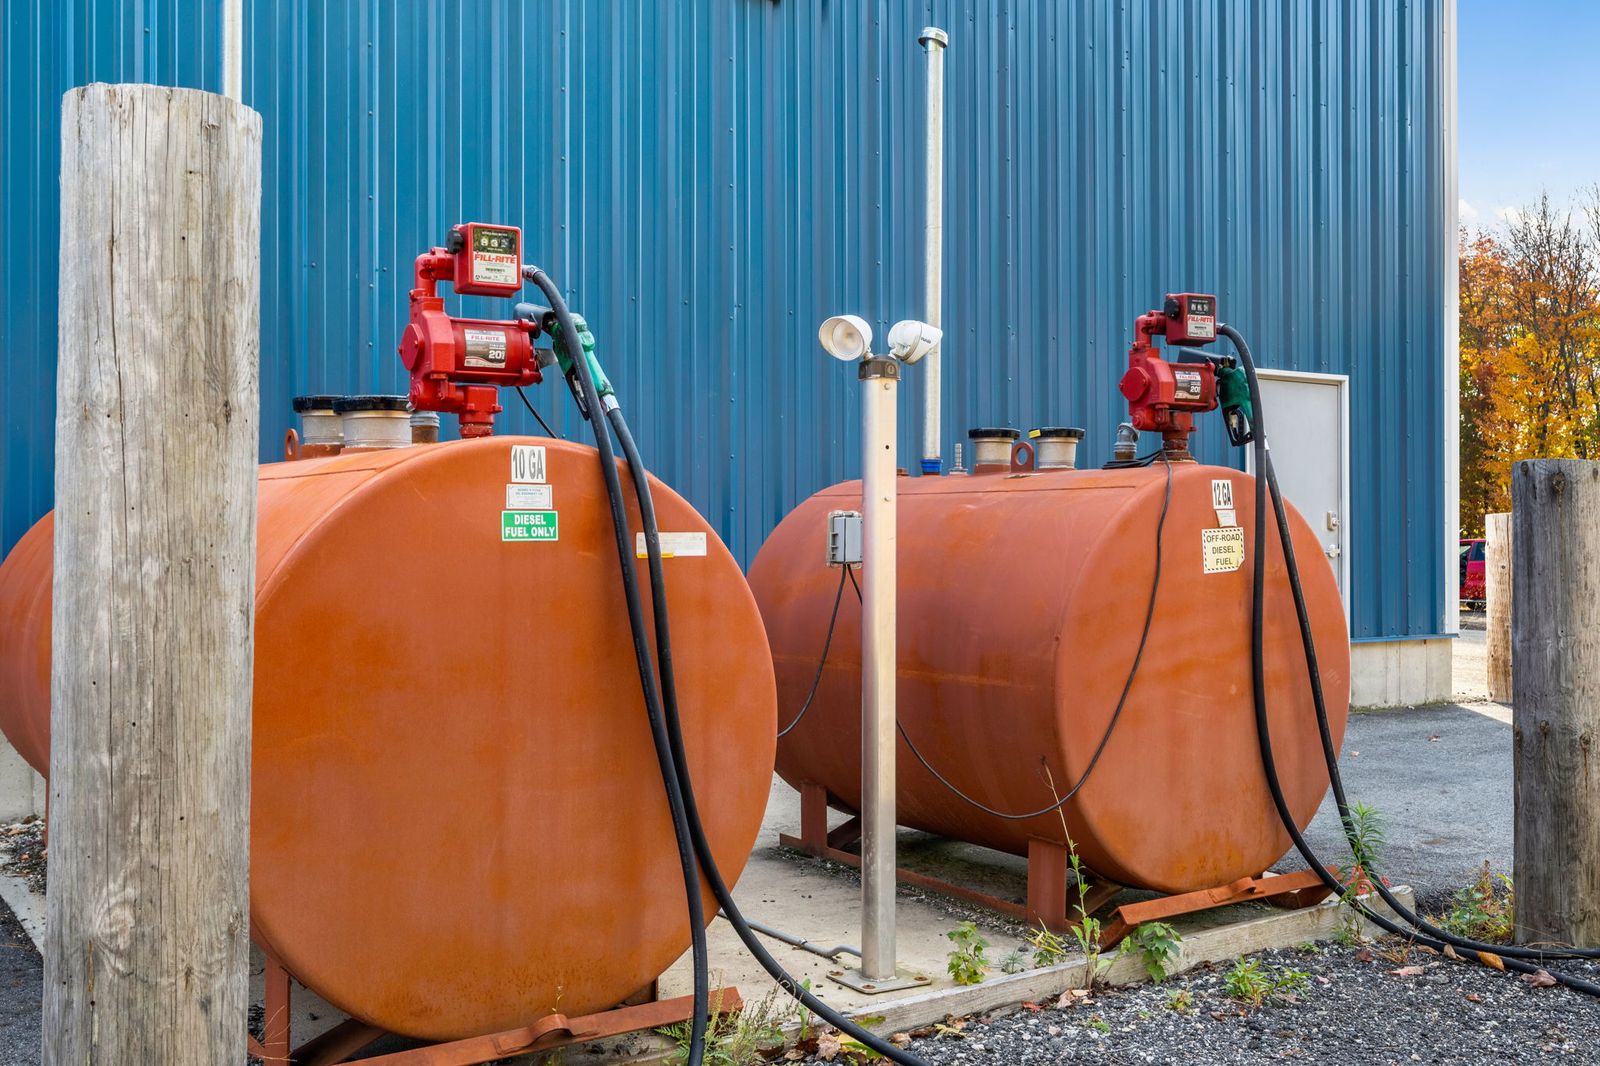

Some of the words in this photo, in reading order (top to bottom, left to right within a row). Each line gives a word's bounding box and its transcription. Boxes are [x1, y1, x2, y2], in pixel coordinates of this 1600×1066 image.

[475, 253, 516, 264] FILL-RITE
[513, 447, 525, 480] 10
[528, 448, 544, 480] GA
[1213, 482, 1222, 506] 12
[1222, 482, 1232, 506] GA
[514, 514, 547, 525] DIESEL
[505, 526, 529, 537] FUEL
[530, 526, 555, 537] ONLY
[1206, 533, 1241, 543] OFF-ROAD
[1212, 545, 1236, 555] DIESEL
[1215, 557, 1233, 566] FUEL
